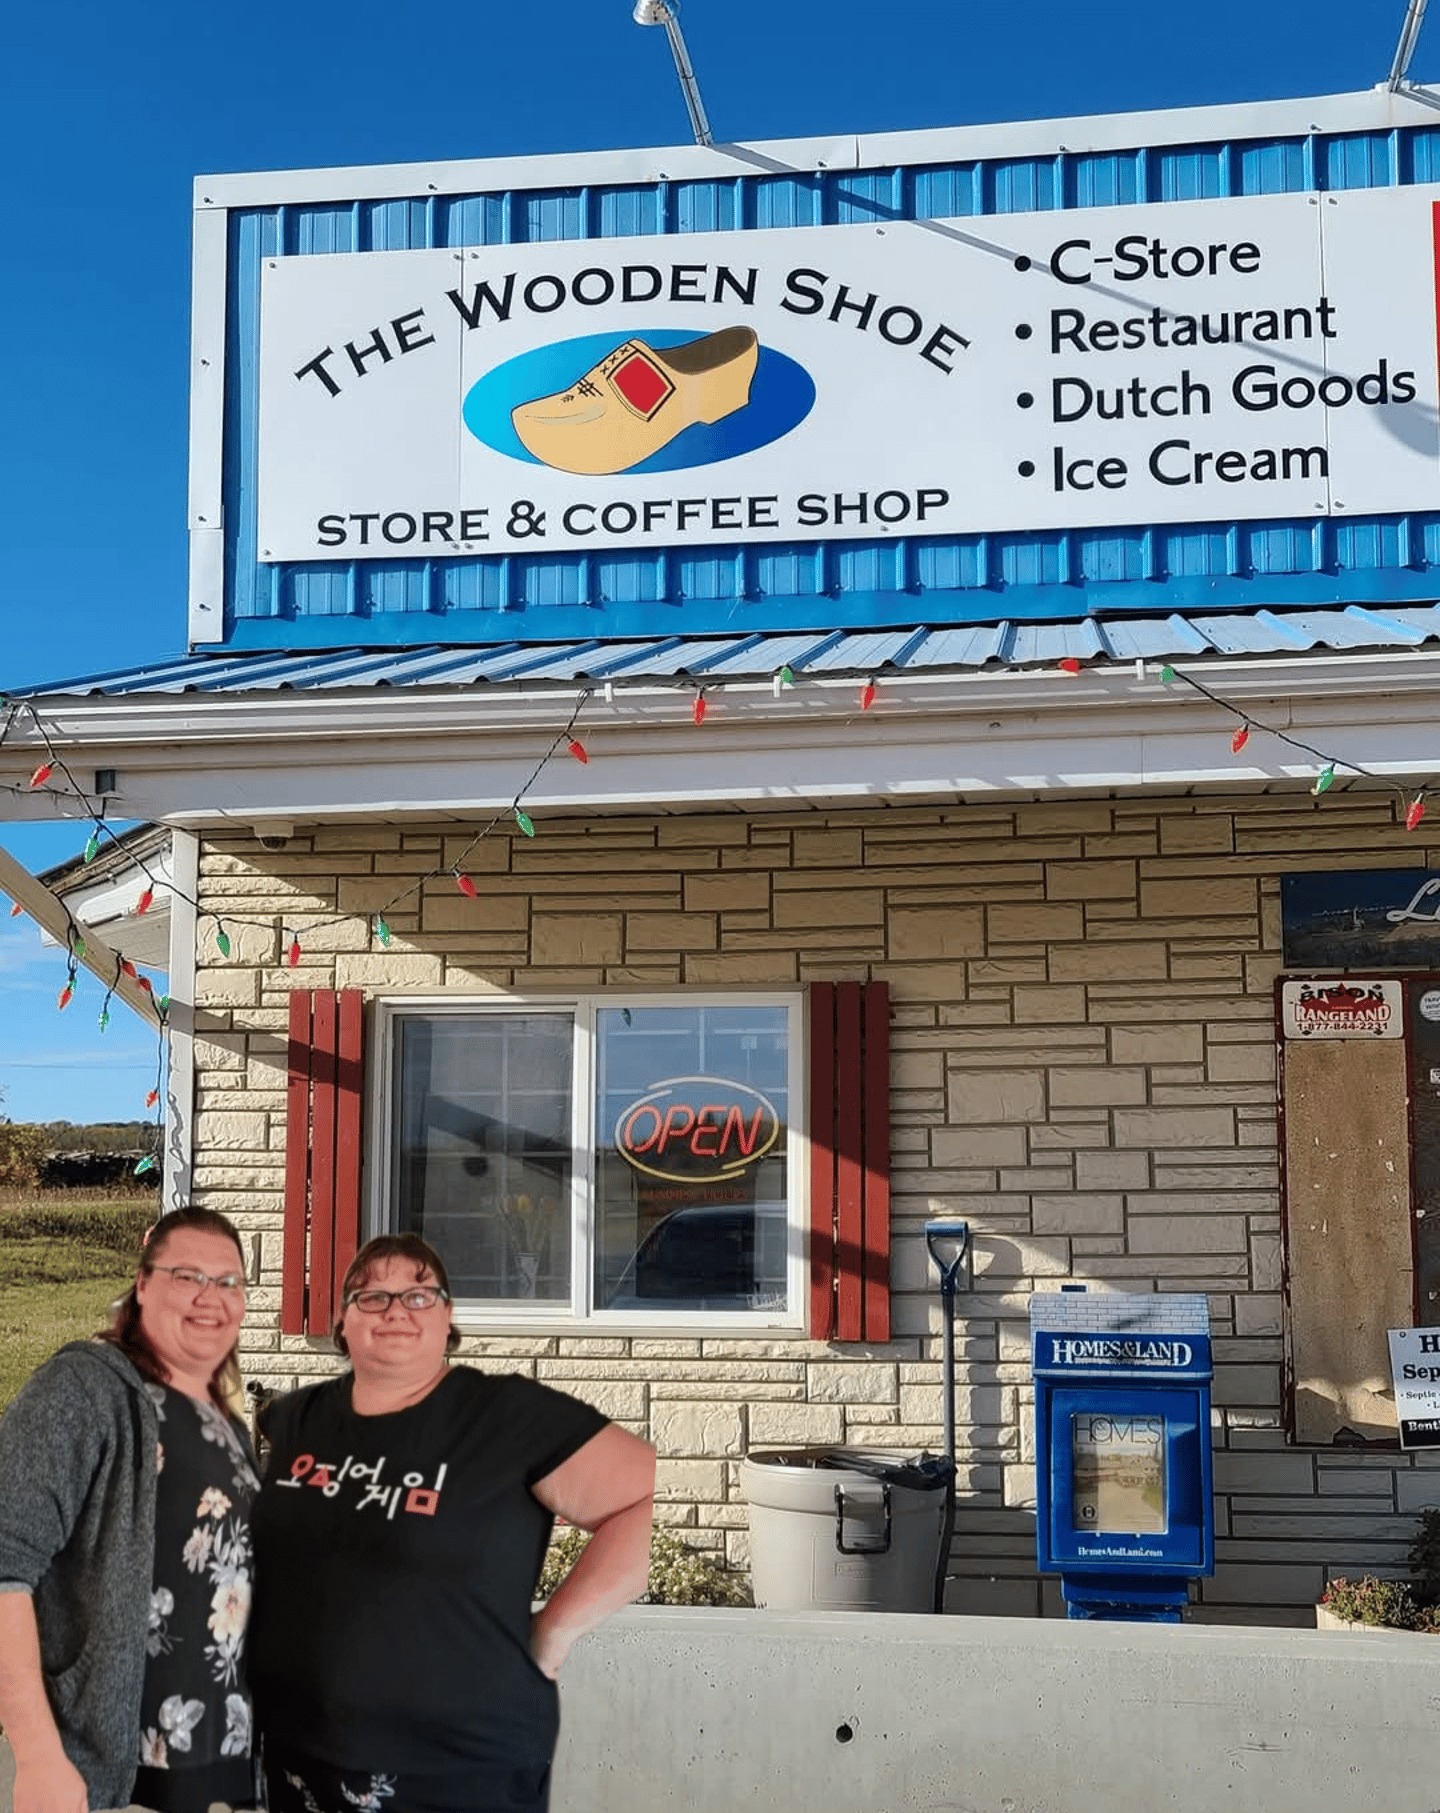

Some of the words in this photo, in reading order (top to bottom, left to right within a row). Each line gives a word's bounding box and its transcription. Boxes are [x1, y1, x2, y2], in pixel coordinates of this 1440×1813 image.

[1050, 235, 1261, 285] C-Store
[294, 307, 436, 398] THE
[445, 264, 760, 331] WOODEN
[779, 267, 972, 376] SHOE
[1051, 296, 1337, 354] Restaurant
[1052, 370, 1211, 423] Dutch
[1232, 358, 1416, 412] Goods
[1054, 446, 1128, 492] Ice
[1148, 439, 1329, 486] Cream
[317, 509, 490, 546] STORE
[506, 500, 546, 539] &
[562, 495, 779, 536] COFFEE
[797, 488, 949, 526] SHOP
[1386, 877, 1440, 922] L
[1295, 1003, 1391, 1022] RANGELAND
[1300, 986, 1384, 1003] BISON
[623, 1104, 764, 1156] OPEN
[1075, 1417, 1161, 1444] HOMES
